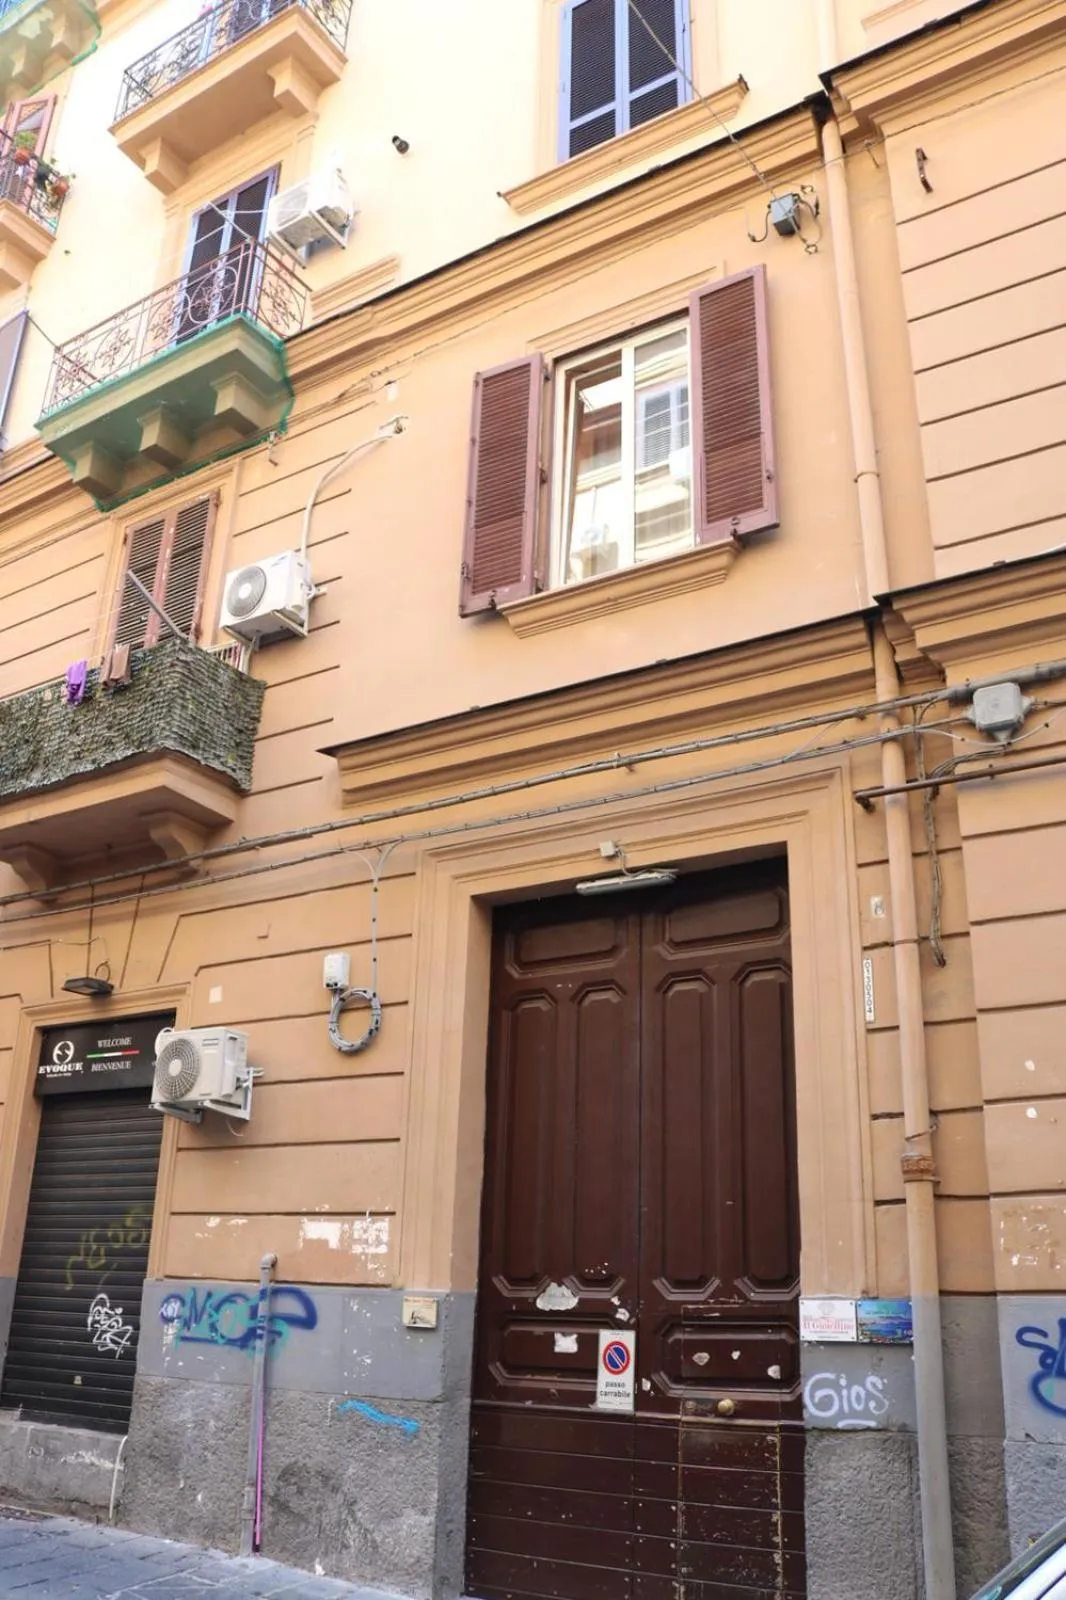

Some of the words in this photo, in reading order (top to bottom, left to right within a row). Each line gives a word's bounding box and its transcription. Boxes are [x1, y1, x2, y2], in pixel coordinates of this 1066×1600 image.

[97, 1037, 132, 1048] WELCOME
[38, 1062, 83, 1074] EVOQUE
[91, 1061, 132, 1072] BIENVENUE
[605, 1381, 626, 1389] passo
[600, 1389, 631, 1399] carrabile
